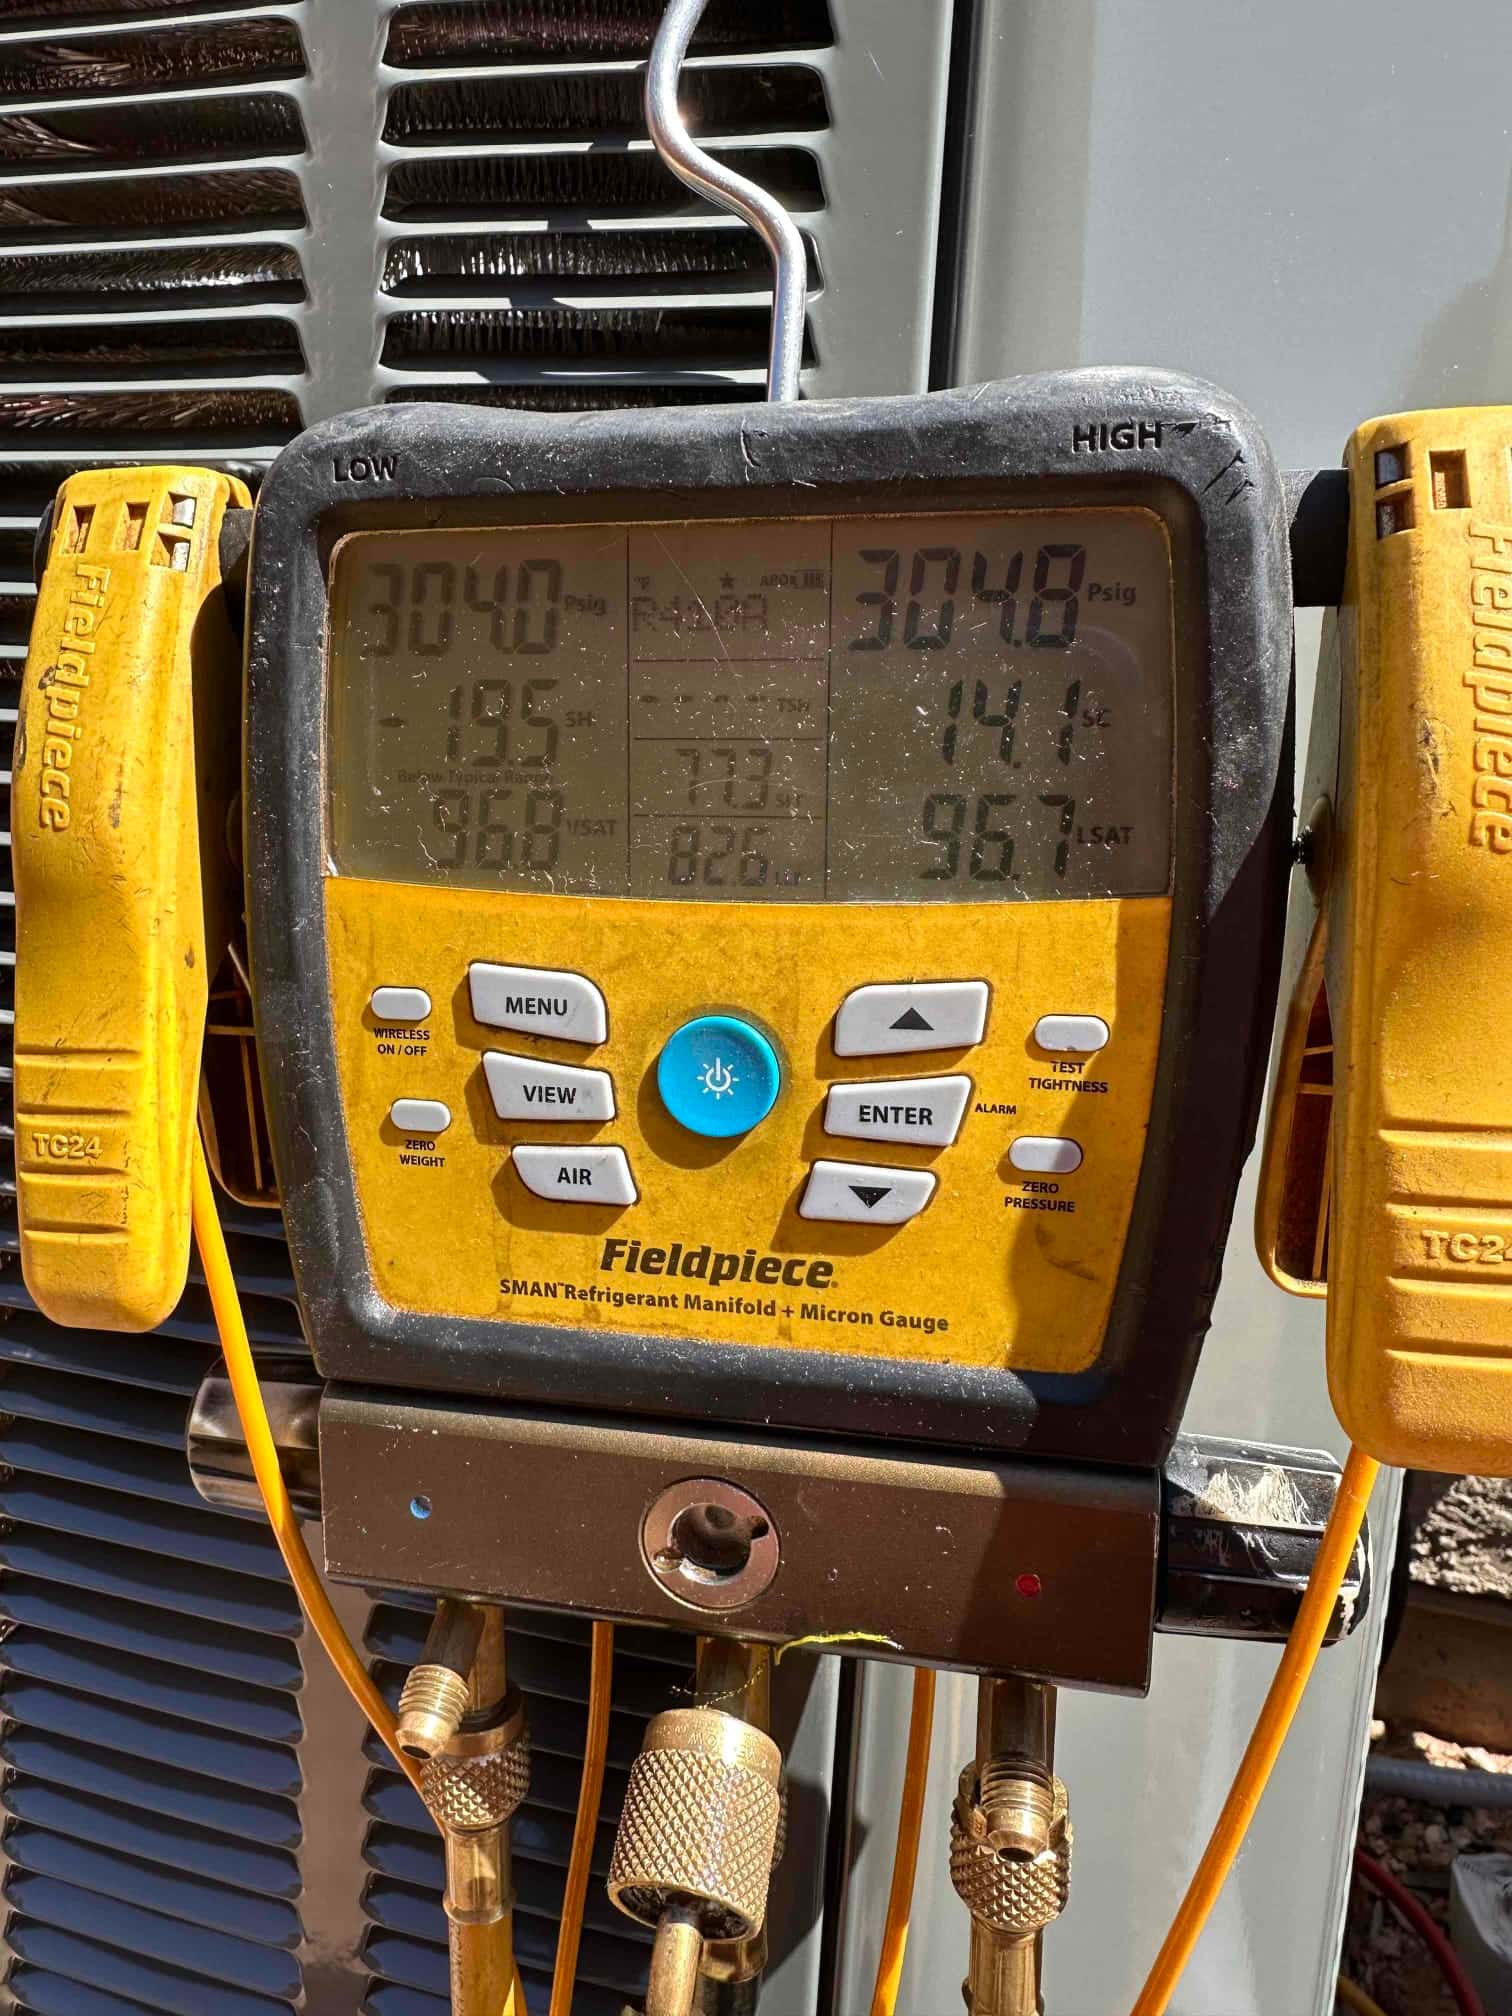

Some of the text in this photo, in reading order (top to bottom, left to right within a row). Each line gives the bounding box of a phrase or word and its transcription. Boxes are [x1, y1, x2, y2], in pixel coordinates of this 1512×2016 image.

[1071, 420, 1163, 453] HIGH
[331, 455, 399, 483] LOW
[565, 593, 608, 617] Psig
[848, 543, 1137, 650] 304.8 Psig
[39, 563, 112, 833] Fieldpiece
[565, 711, 592, 728] SH
[942, 679, 1112, 769] 14.1 SC
[919, 793, 1134, 881] 96.7 LSAT
[504, 995, 569, 1017] MENU
[373, 1026, 431, 1041] WIRELESS
[376, 1043, 396, 1056] ON
[404, 1045, 428, 1057] OFF
[1050, 1060, 1086, 1075] TEST
[522, 1084, 578, 1106] VIEW
[1028, 1076, 1109, 1094] TIGHTNESS
[858, 1104, 934, 1126] ENTER
[974, 1102, 1018, 1116] ALARM
[32, 1132, 104, 1159] TC24
[405, 1139, 436, 1152] ZERO
[399, 1154, 446, 1169] WEIGHT
[556, 1167, 593, 1187] AIR
[1021, 1180, 1060, 1195] ZERO
[1004, 1196, 1076, 1214] PRESSURE
[600, 1237, 838, 1290] Fieldpiece
[564, 1283, 679, 1309] Refrigerant
[684, 1293, 777, 1318] Manifold
[800, 1303, 874, 1326] Micron
[879, 1309, 950, 1336] Gauge
